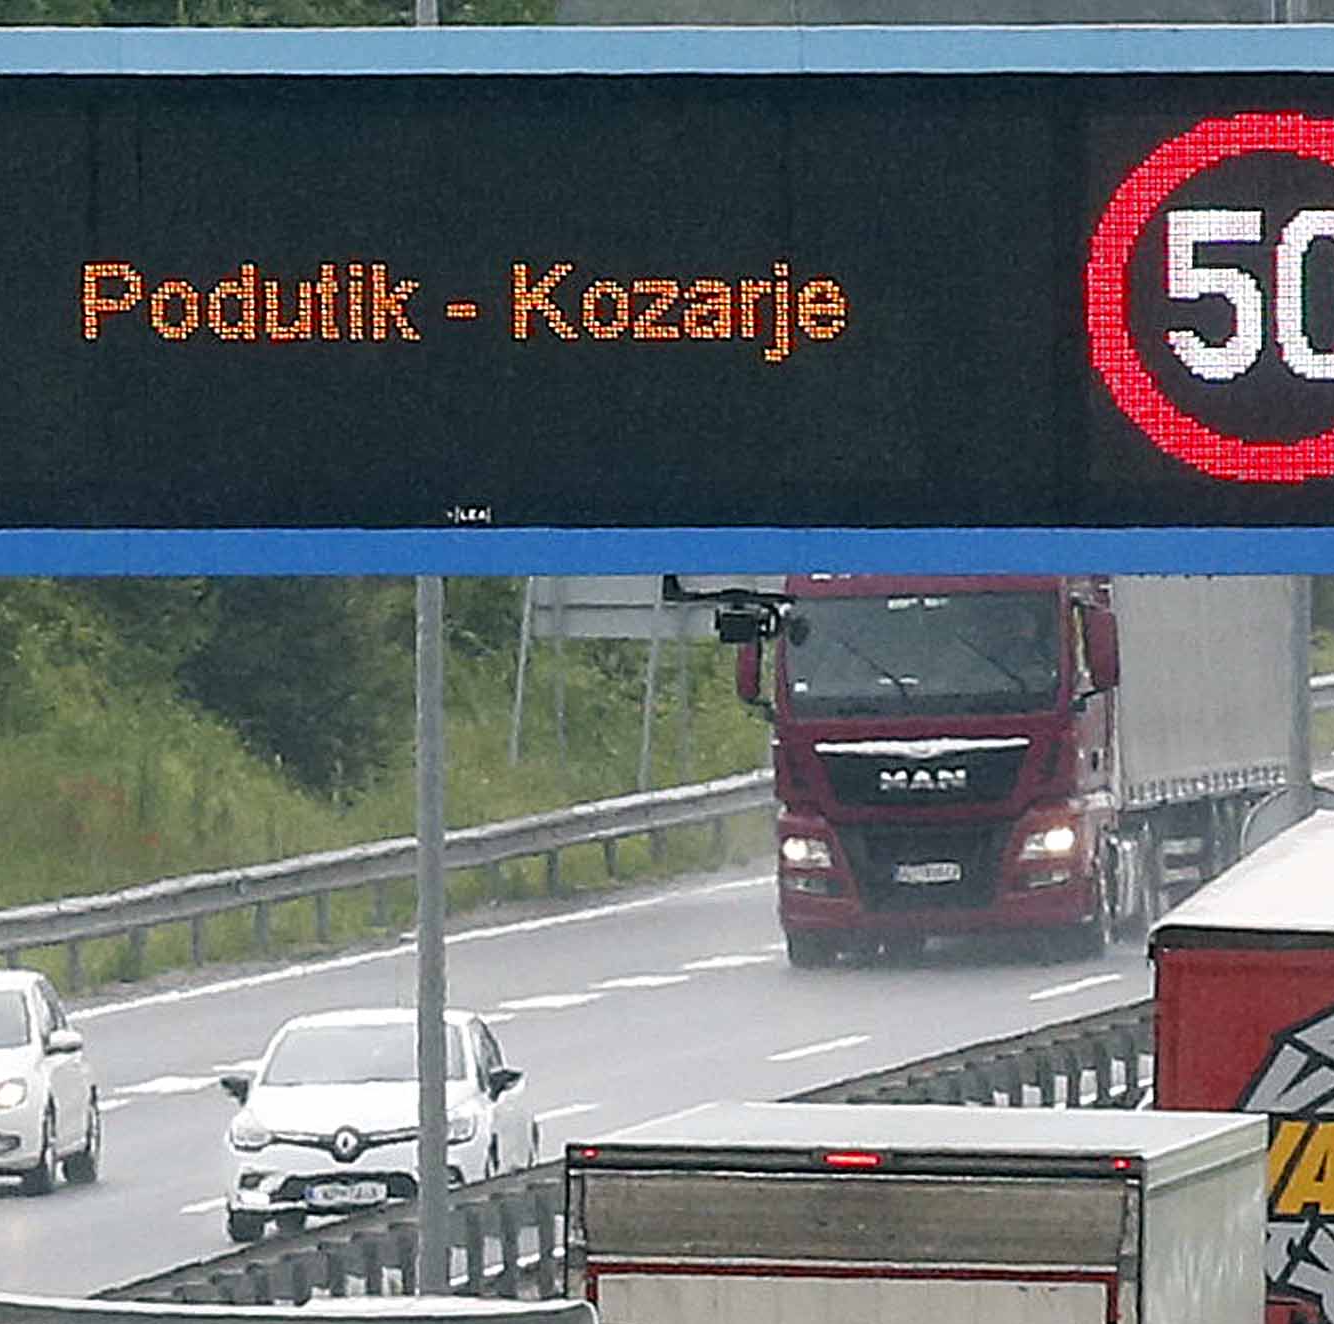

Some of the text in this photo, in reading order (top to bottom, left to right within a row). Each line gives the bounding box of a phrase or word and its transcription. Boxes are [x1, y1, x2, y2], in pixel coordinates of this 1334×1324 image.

[81, 261, 421, 341] Podutik
[509, 261, 849, 360] Kozarje
[880, 769, 966, 790] MAN
